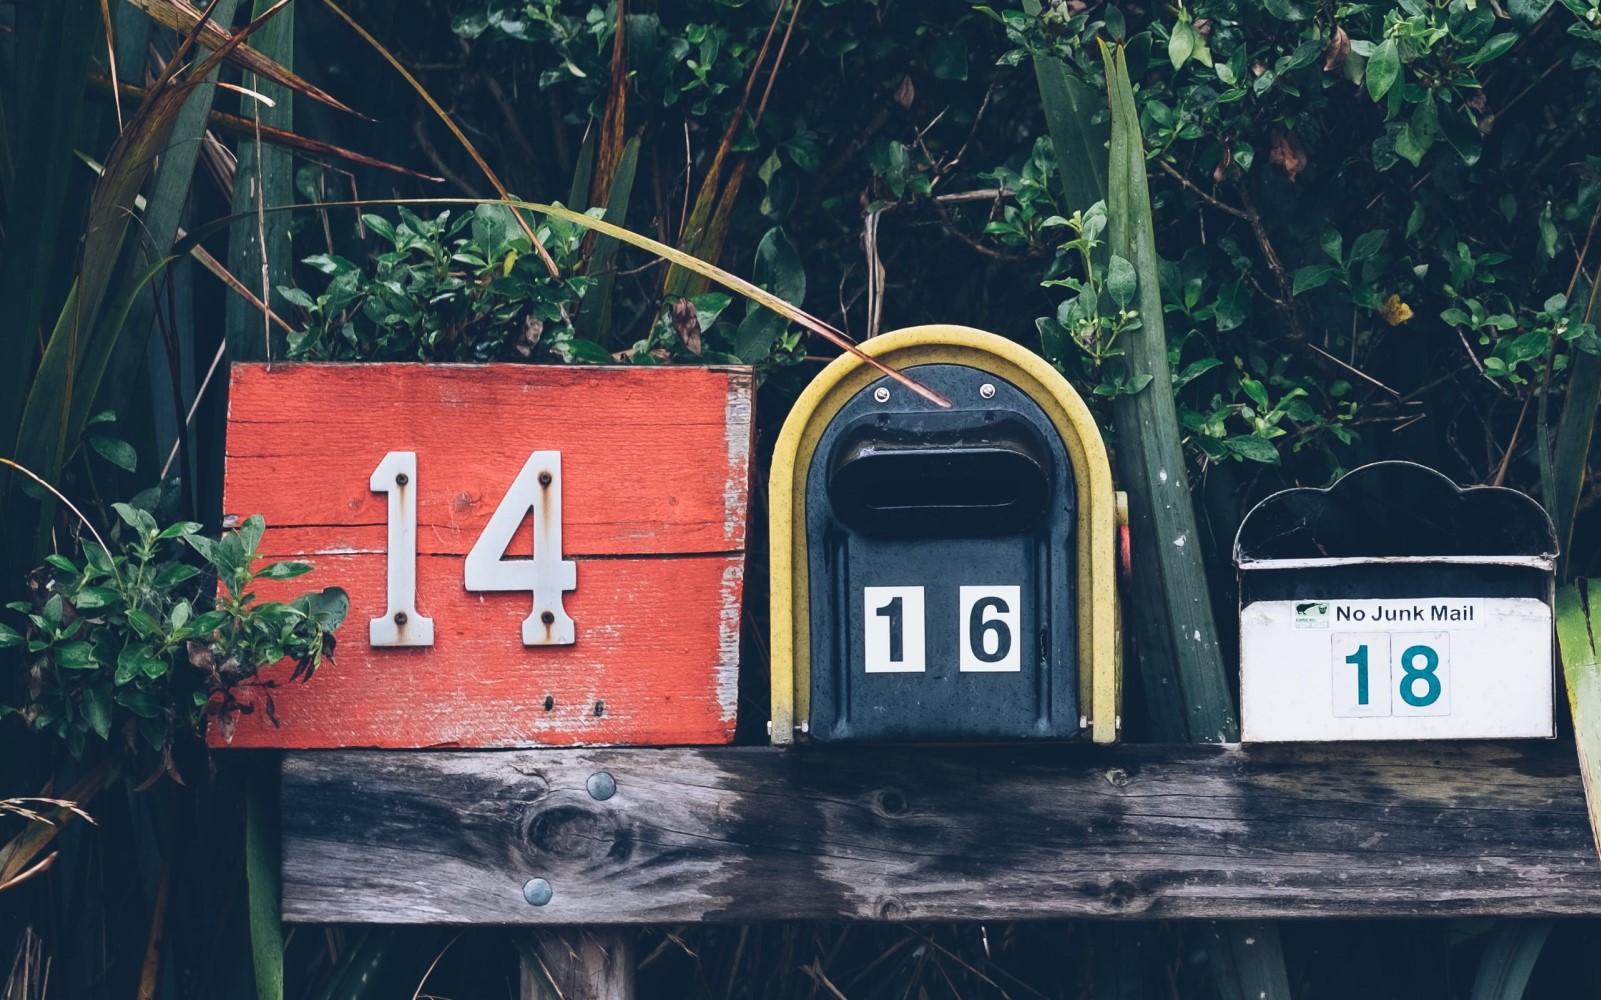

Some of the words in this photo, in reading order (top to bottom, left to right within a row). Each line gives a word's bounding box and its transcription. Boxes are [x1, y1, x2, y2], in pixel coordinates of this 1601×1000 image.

[369, 450, 577, 648] 14
[874, 596, 1014, 663] 16
[1336, 606, 1365, 622] No
[1371, 605, 1425, 622] Junk
[1431, 604, 1474, 621] Mail
[1345, 644, 1442, 707] 18
